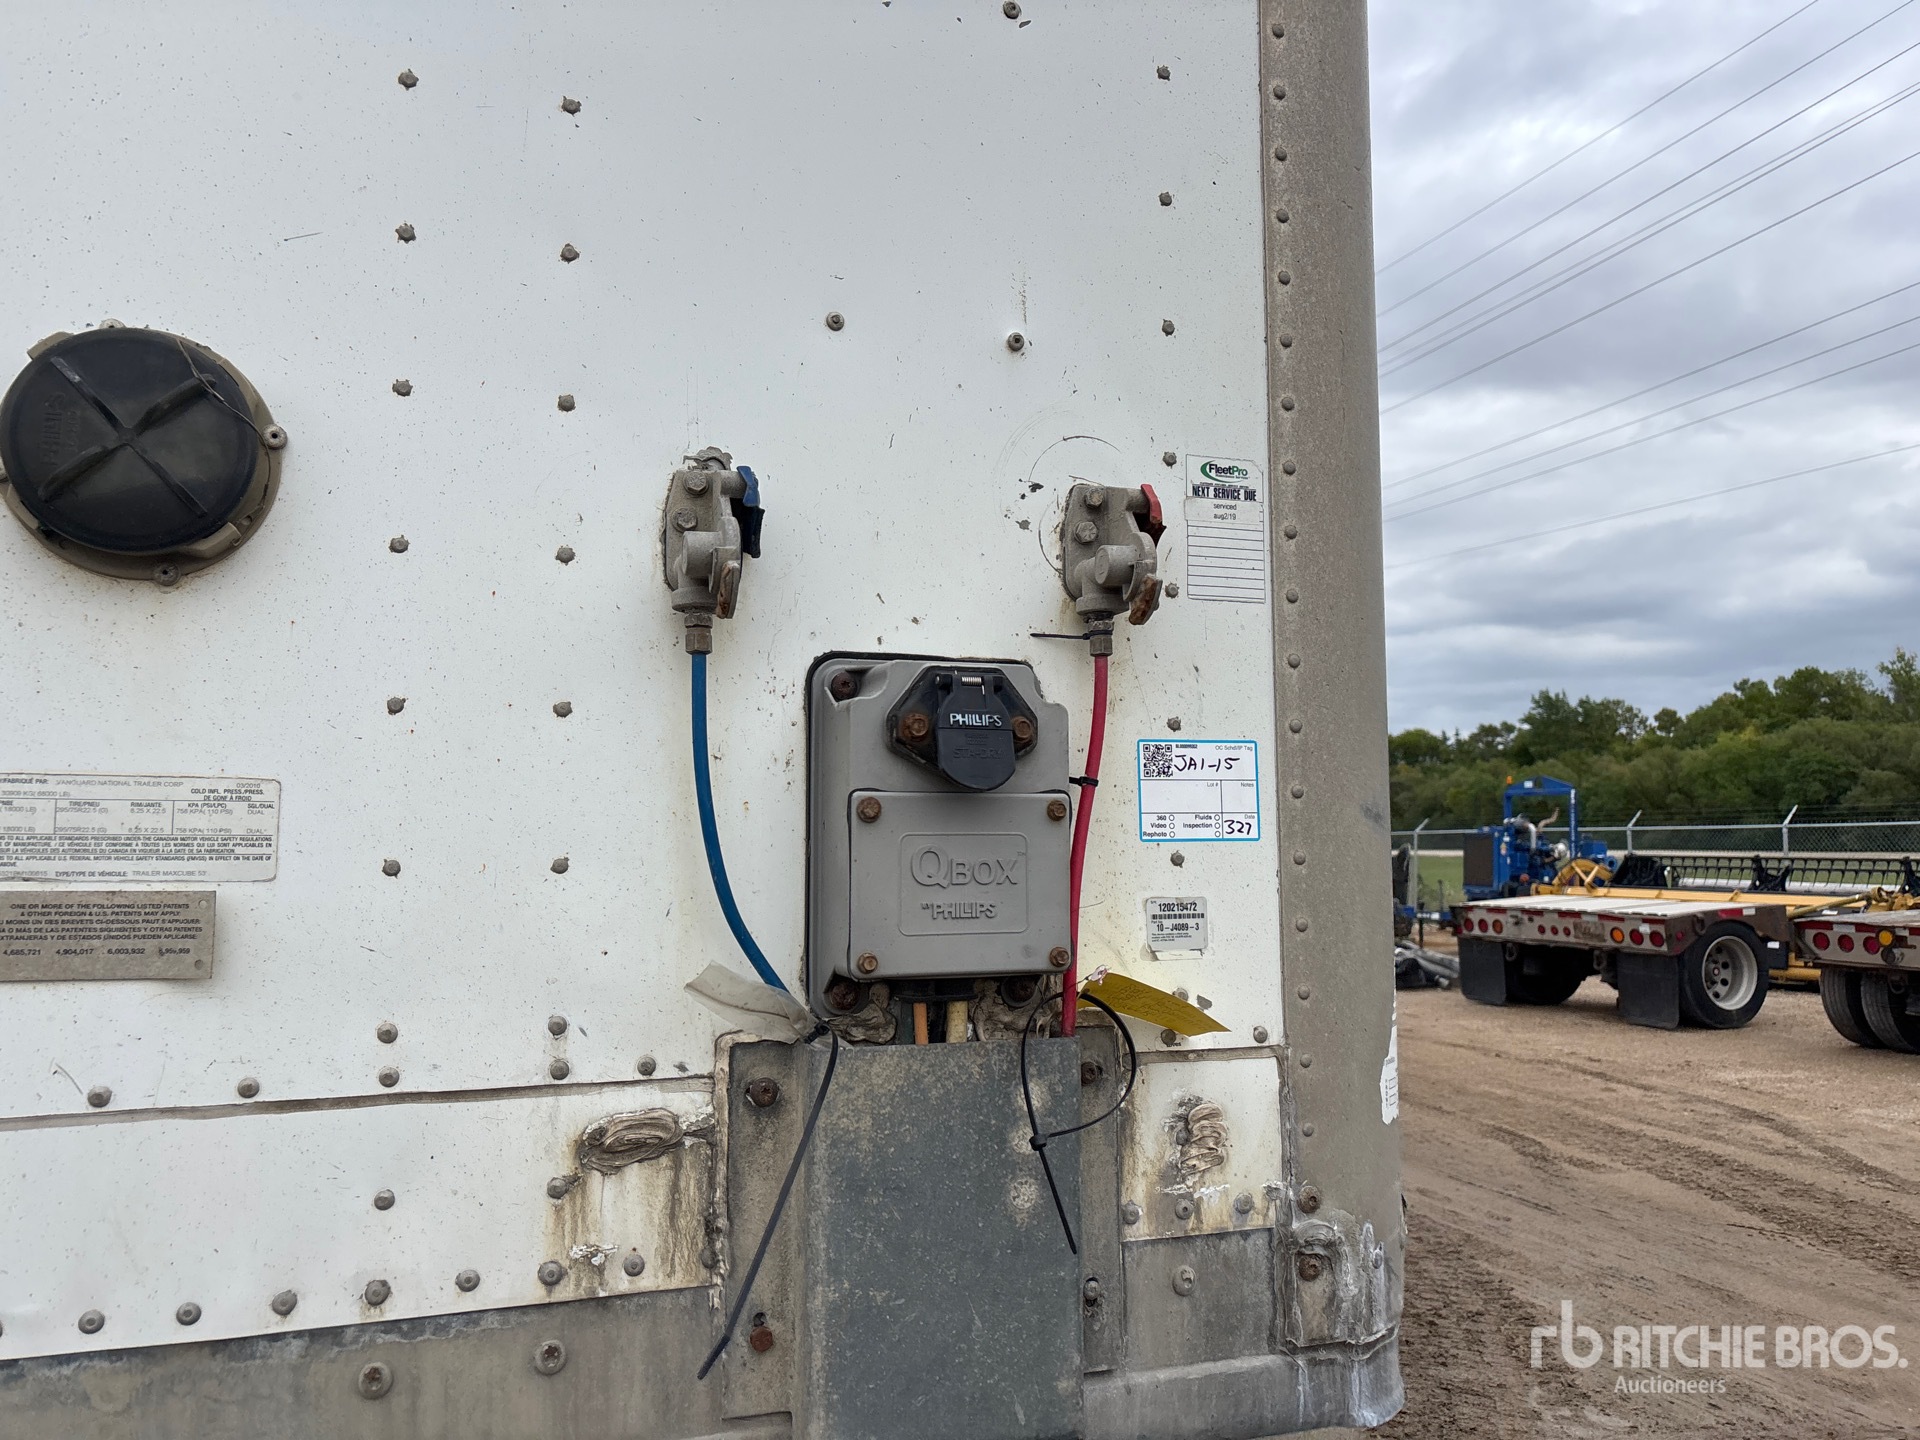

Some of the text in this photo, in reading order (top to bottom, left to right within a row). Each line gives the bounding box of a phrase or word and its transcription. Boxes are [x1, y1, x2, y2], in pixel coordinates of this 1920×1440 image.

[1209, 464, 1248, 476] FleetPro
[1192, 486, 1256, 502] NEXT SERVICE DUE
[950, 712, 1002, 727] PHILLIPS
[1224, 820, 1252, 836] 327
[911, 844, 1018, 889] QBOX
[931, 902, 997, 920] PHILLIPS
[56, 948, 94, 956] 4,904,017
[107, 948, 146, 956] 6,003,932
